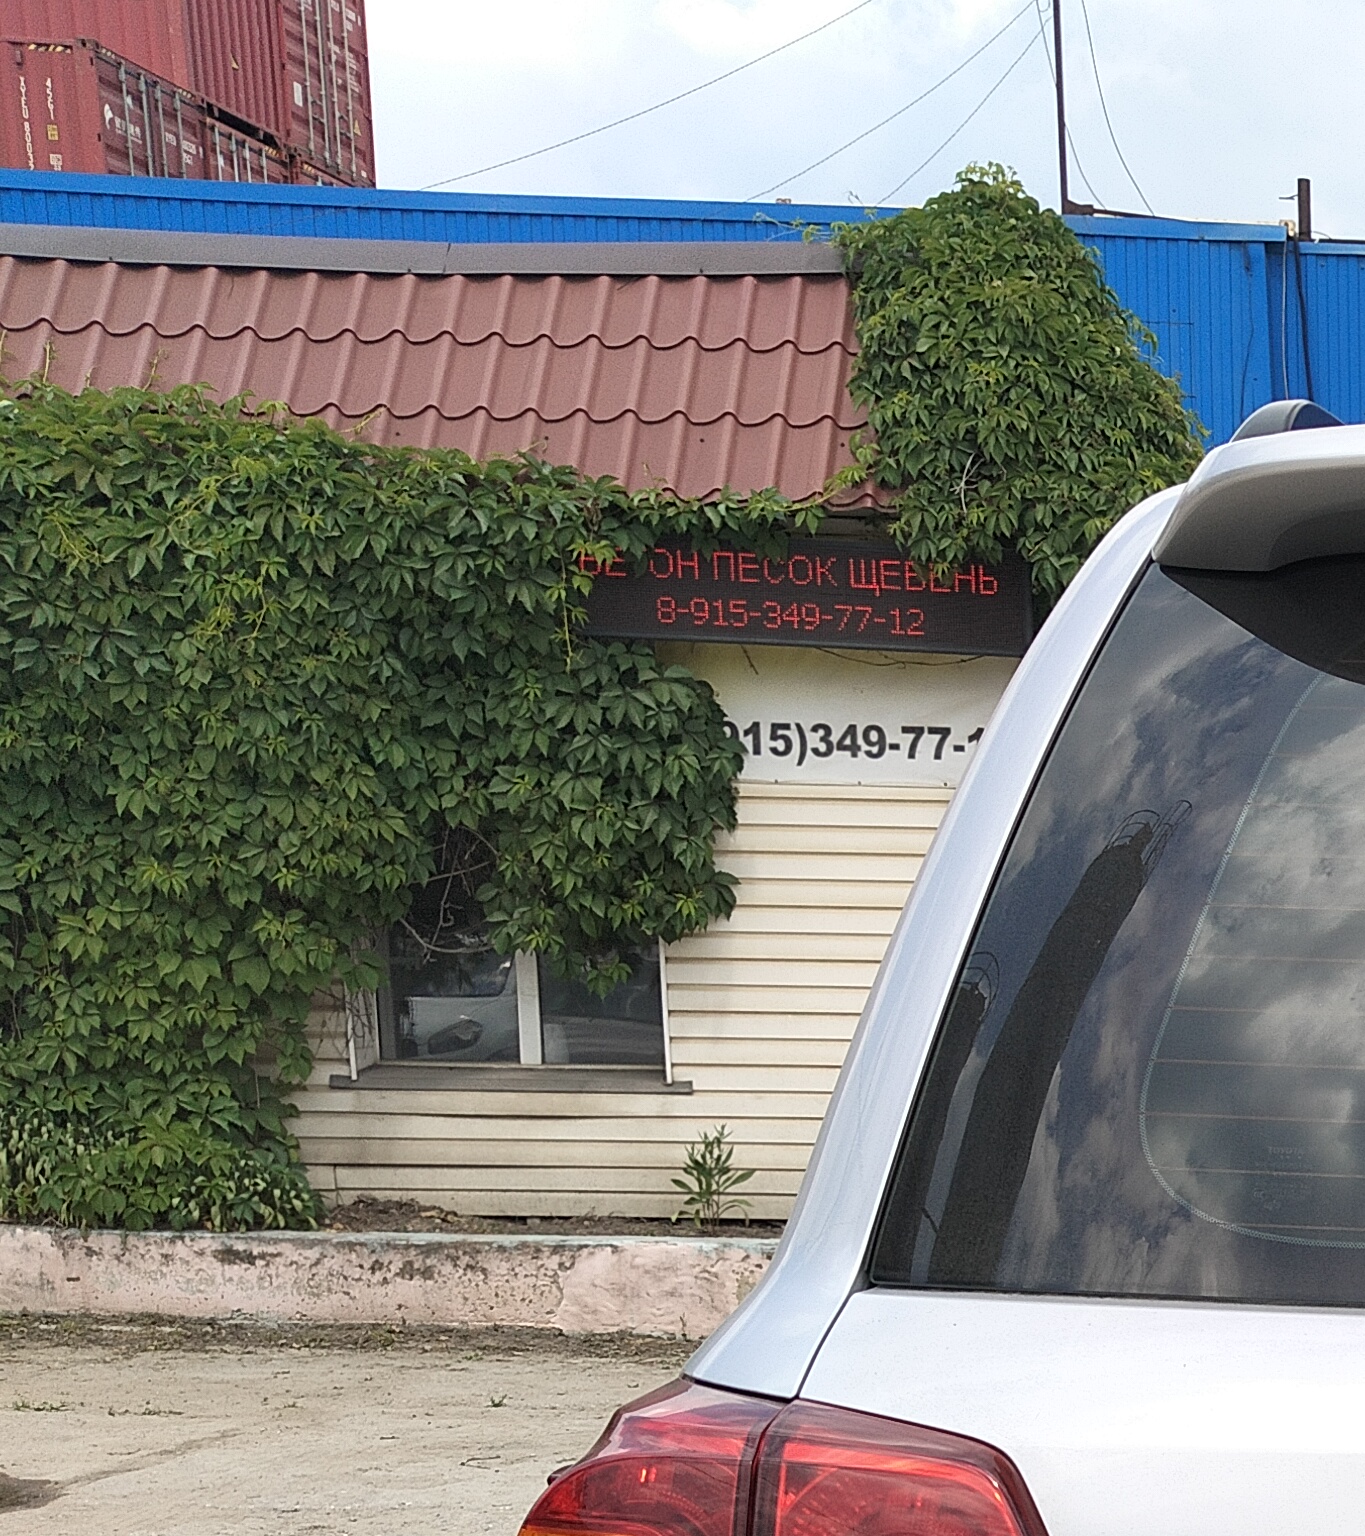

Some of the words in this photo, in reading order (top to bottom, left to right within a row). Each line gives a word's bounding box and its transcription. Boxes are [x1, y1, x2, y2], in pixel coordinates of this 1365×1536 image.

[577, 546, 699, 580] БЕОН
[713, 551, 838, 587] ПЕСОК
[655, 595, 926, 637] 8-915-349-77-12
